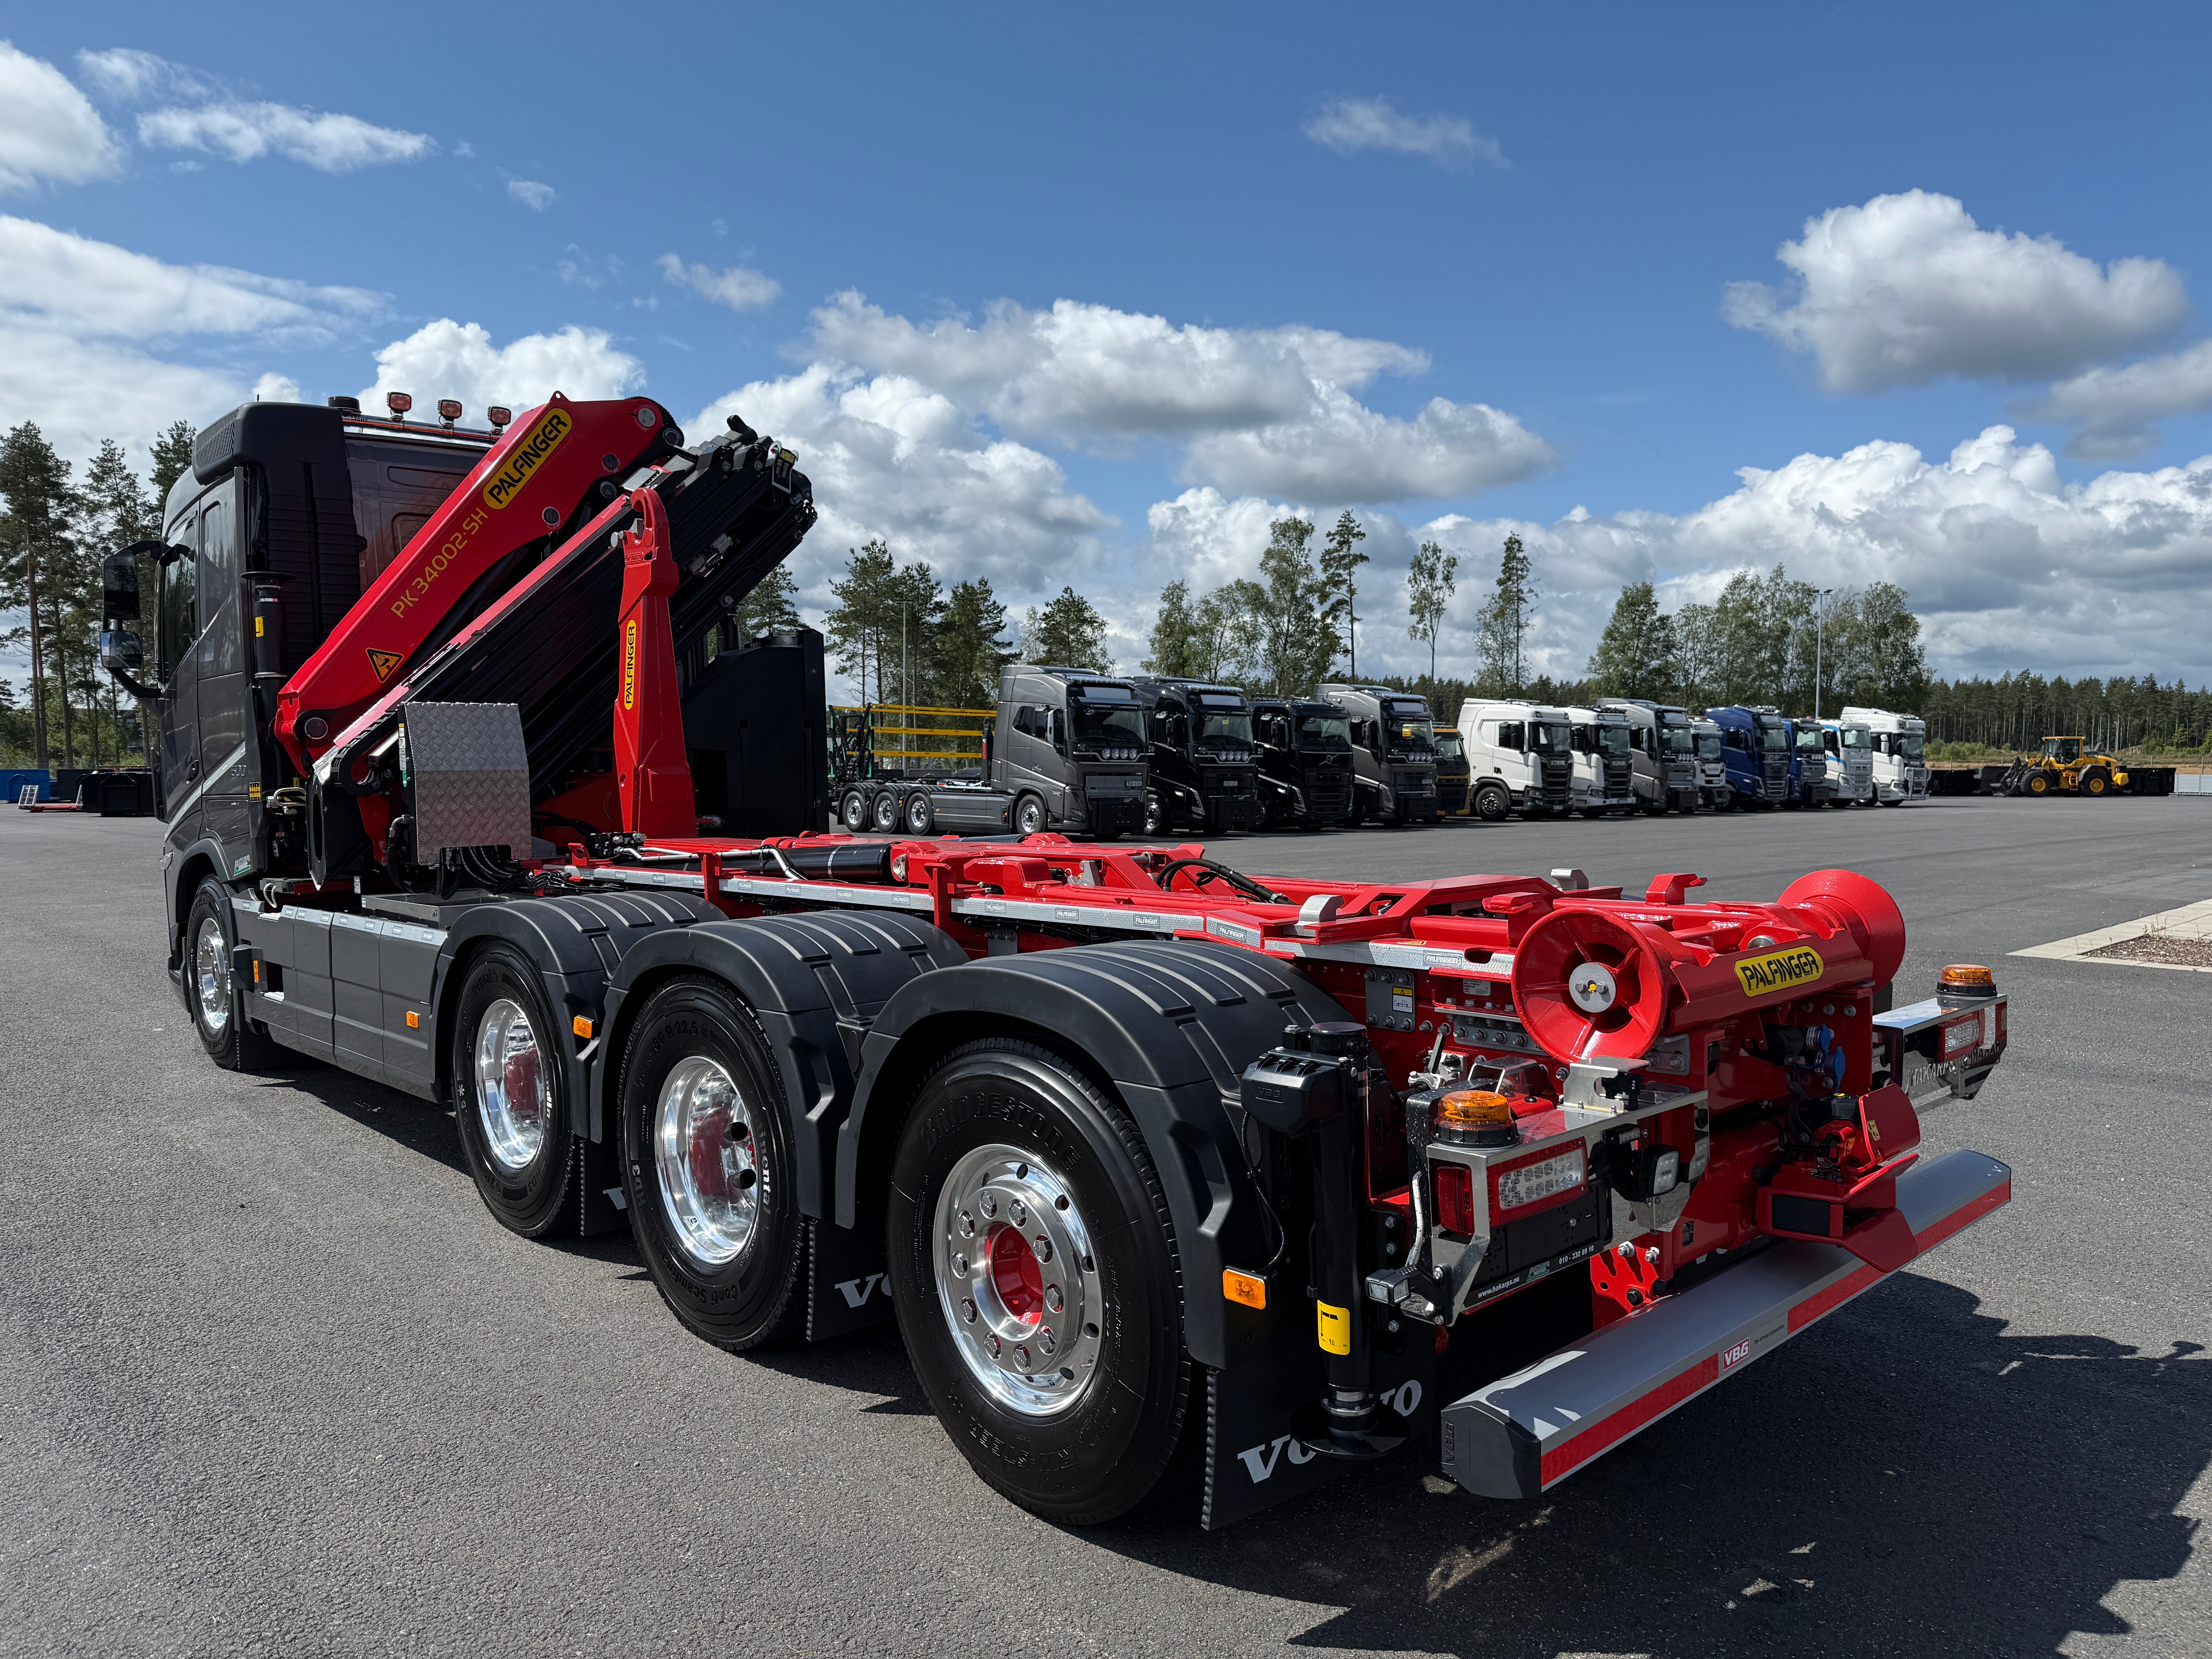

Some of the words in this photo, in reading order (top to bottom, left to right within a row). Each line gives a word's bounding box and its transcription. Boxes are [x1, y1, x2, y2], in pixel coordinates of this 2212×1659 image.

[487, 414, 569, 504] PALFINGER
[390, 589, 419, 619] PK
[625, 623, 635, 706] PALFINGER
[1135, 917, 1159, 926] PALFINGER
[1219, 927, 1245, 939] PALFINGER
[1426, 954, 1460, 964] PALFINGER
[1740, 951, 1819, 991] PALFINGER
[920, 1092, 1082, 1171] BRIDGESTONE
[632, 1164, 647, 1207] HD3
[1559, 1255, 1568, 1264] 010
[1572, 1250, 1581, 1260] 330
[711, 1285, 738, 1306] Conti
[1478, 1276, 1520, 1298] www.hakarps.nu
[1724, 1341, 1749, 1366] VBG
[1759, 1333, 1769, 1342] strong
[1769, 1324, 1784, 1336] connection
